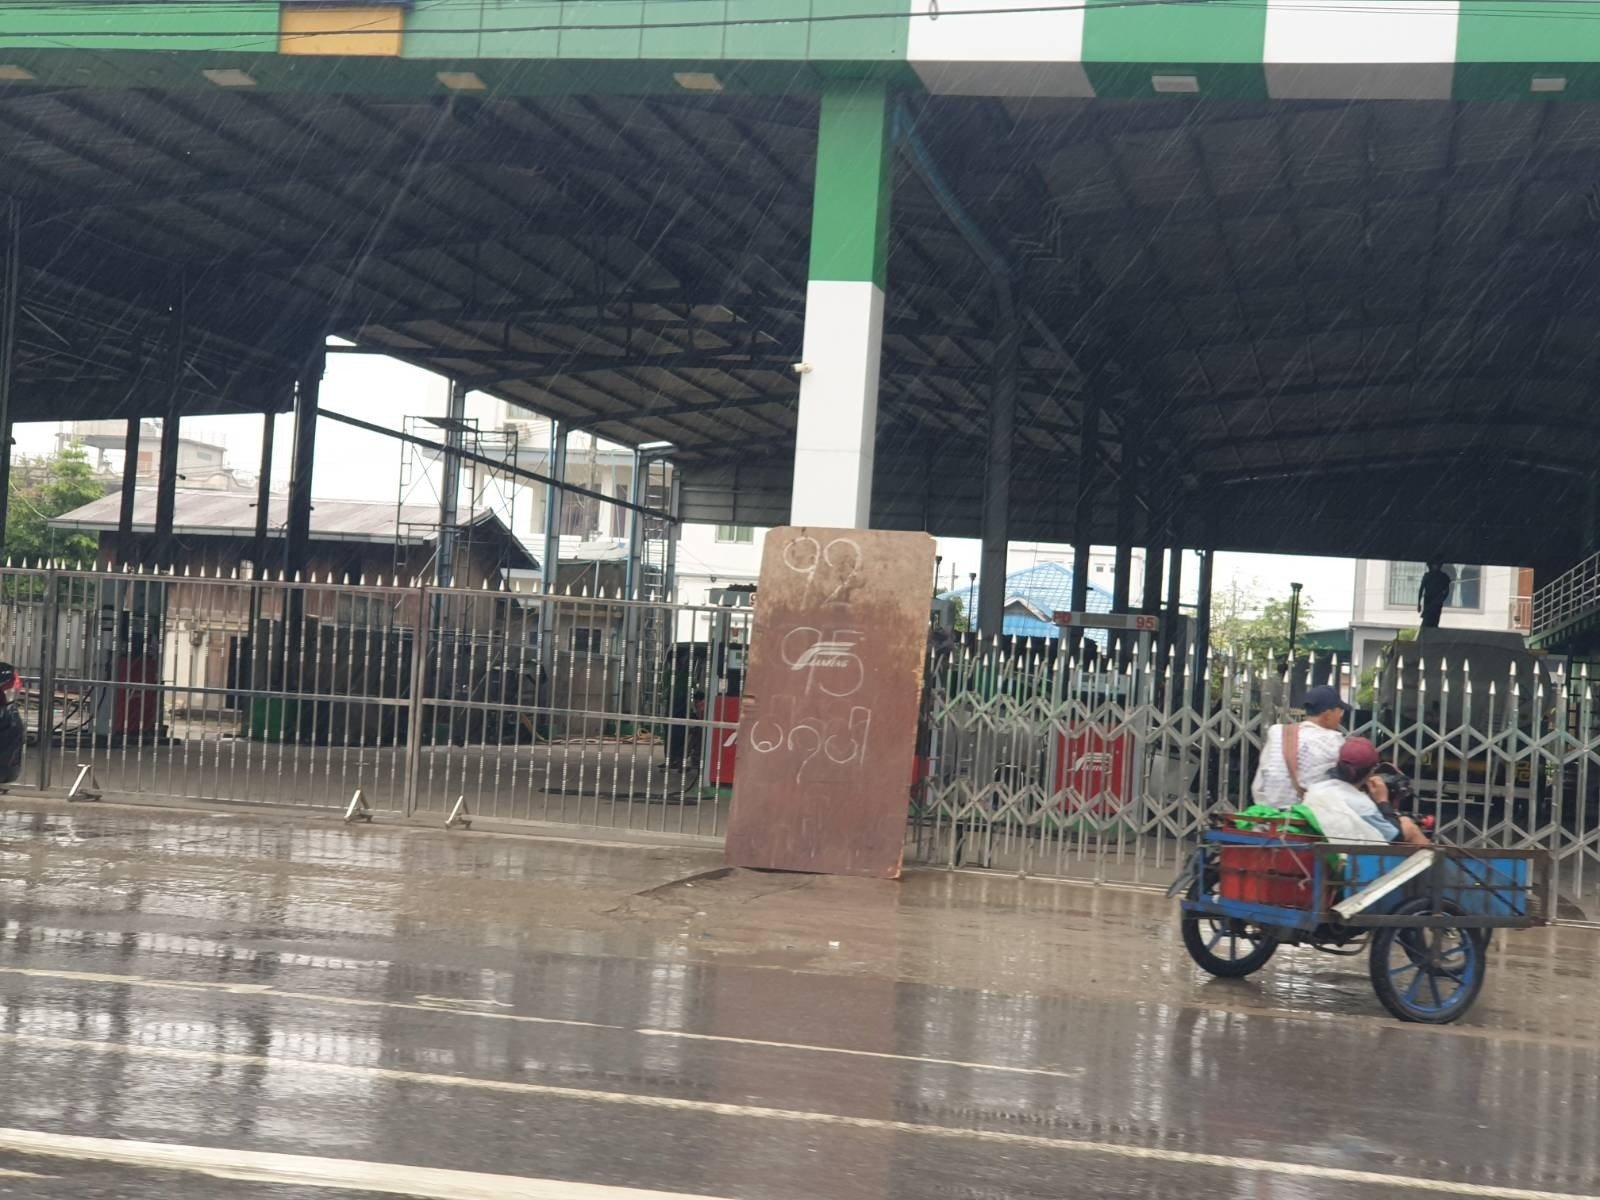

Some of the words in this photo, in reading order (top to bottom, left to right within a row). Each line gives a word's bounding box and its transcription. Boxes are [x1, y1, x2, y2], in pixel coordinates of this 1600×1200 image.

[783, 536, 861, 610] 92
[1135, 615, 1155, 629] 95
[781, 626, 864, 697] 95
